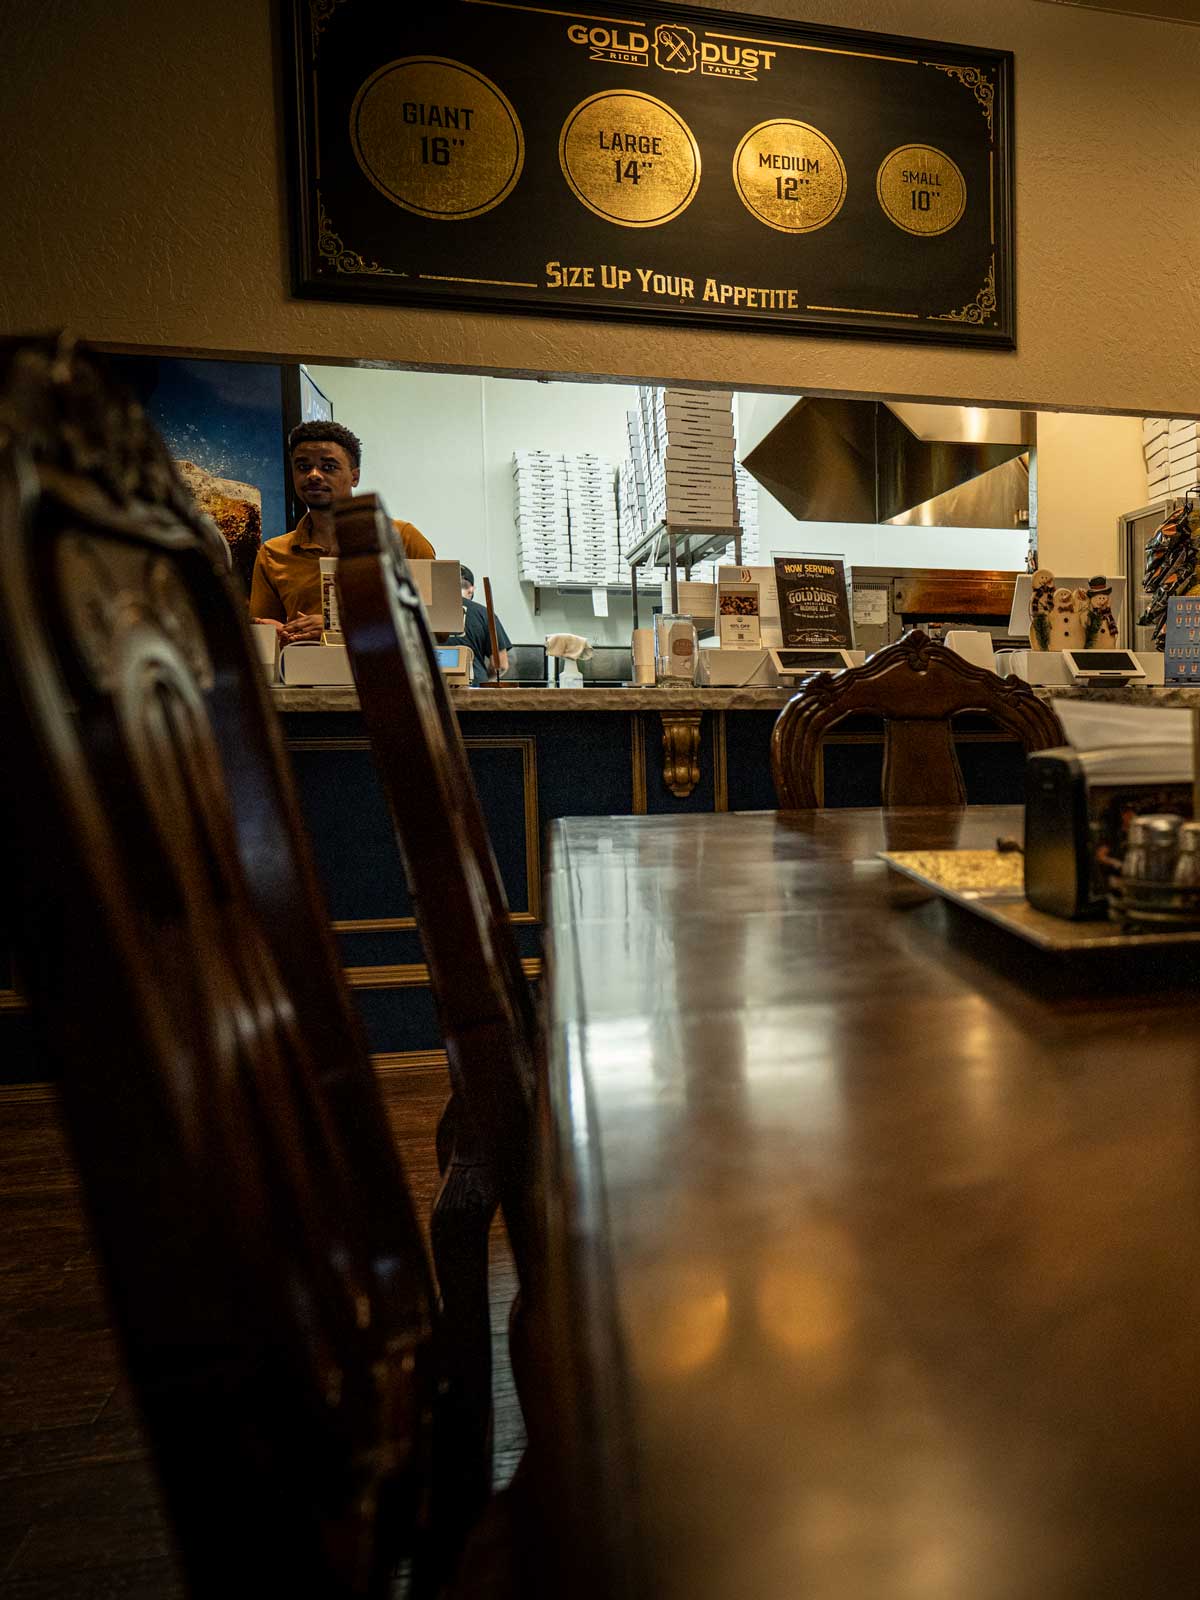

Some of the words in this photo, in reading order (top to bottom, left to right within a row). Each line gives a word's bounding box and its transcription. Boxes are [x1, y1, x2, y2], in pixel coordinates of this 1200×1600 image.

[567, 24, 649, 53] GOLD
[701, 42, 777, 70] DUST
[609, 52, 638, 63] RICH
[707, 65, 741, 76] TASTE
[402, 101, 474, 132] GIANT
[420, 136, 465, 167] 16"
[599, 130, 663, 157] LARGE
[614, 159, 653, 186] 14"
[758, 152, 820, 176] MEDIUM
[775, 176, 810, 203] 12"
[901, 169, 942, 187] SMALL
[910, 189, 941, 212] 10"
[546, 261, 596, 290] SIZE
[600, 264, 632, 293] UP
[635, 268, 695, 299] YOUR
[702, 278, 800, 310] APPETITE
[784, 564, 803, 573] NOW
[804, 564, 835, 575] SERVING
[788, 591, 813, 604] GOLD
[813, 591, 838, 605] DUST
